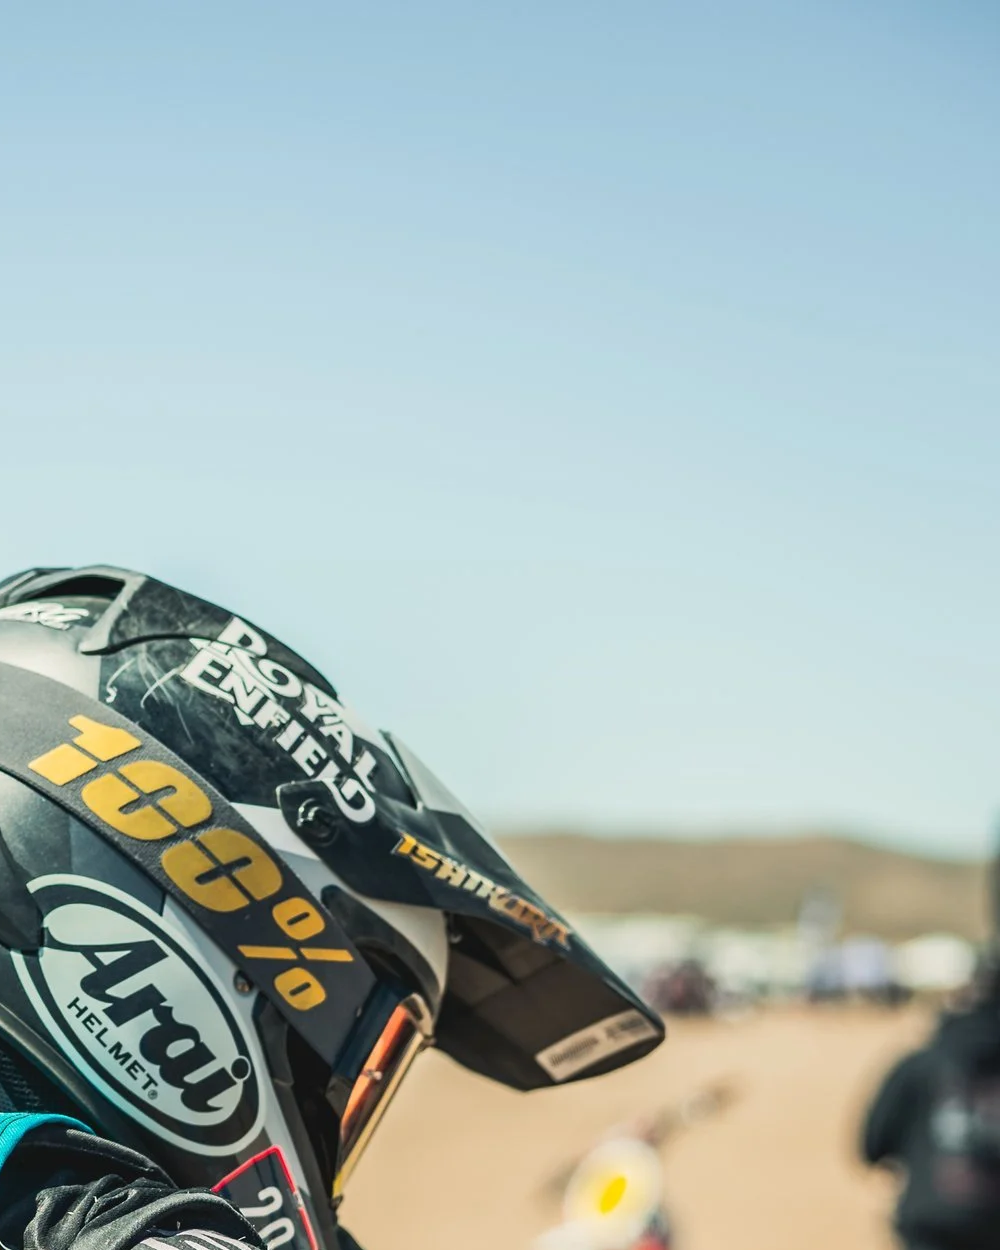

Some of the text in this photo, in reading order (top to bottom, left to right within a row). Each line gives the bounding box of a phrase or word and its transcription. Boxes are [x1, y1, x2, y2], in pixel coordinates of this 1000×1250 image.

[180, 650, 376, 824] ENFIELD
[189, 615, 377, 794] ROYAL
[27, 713, 354, 1011] 100%
[43, 926, 251, 1112] Arai
[66, 995, 159, 1092] HELMET
